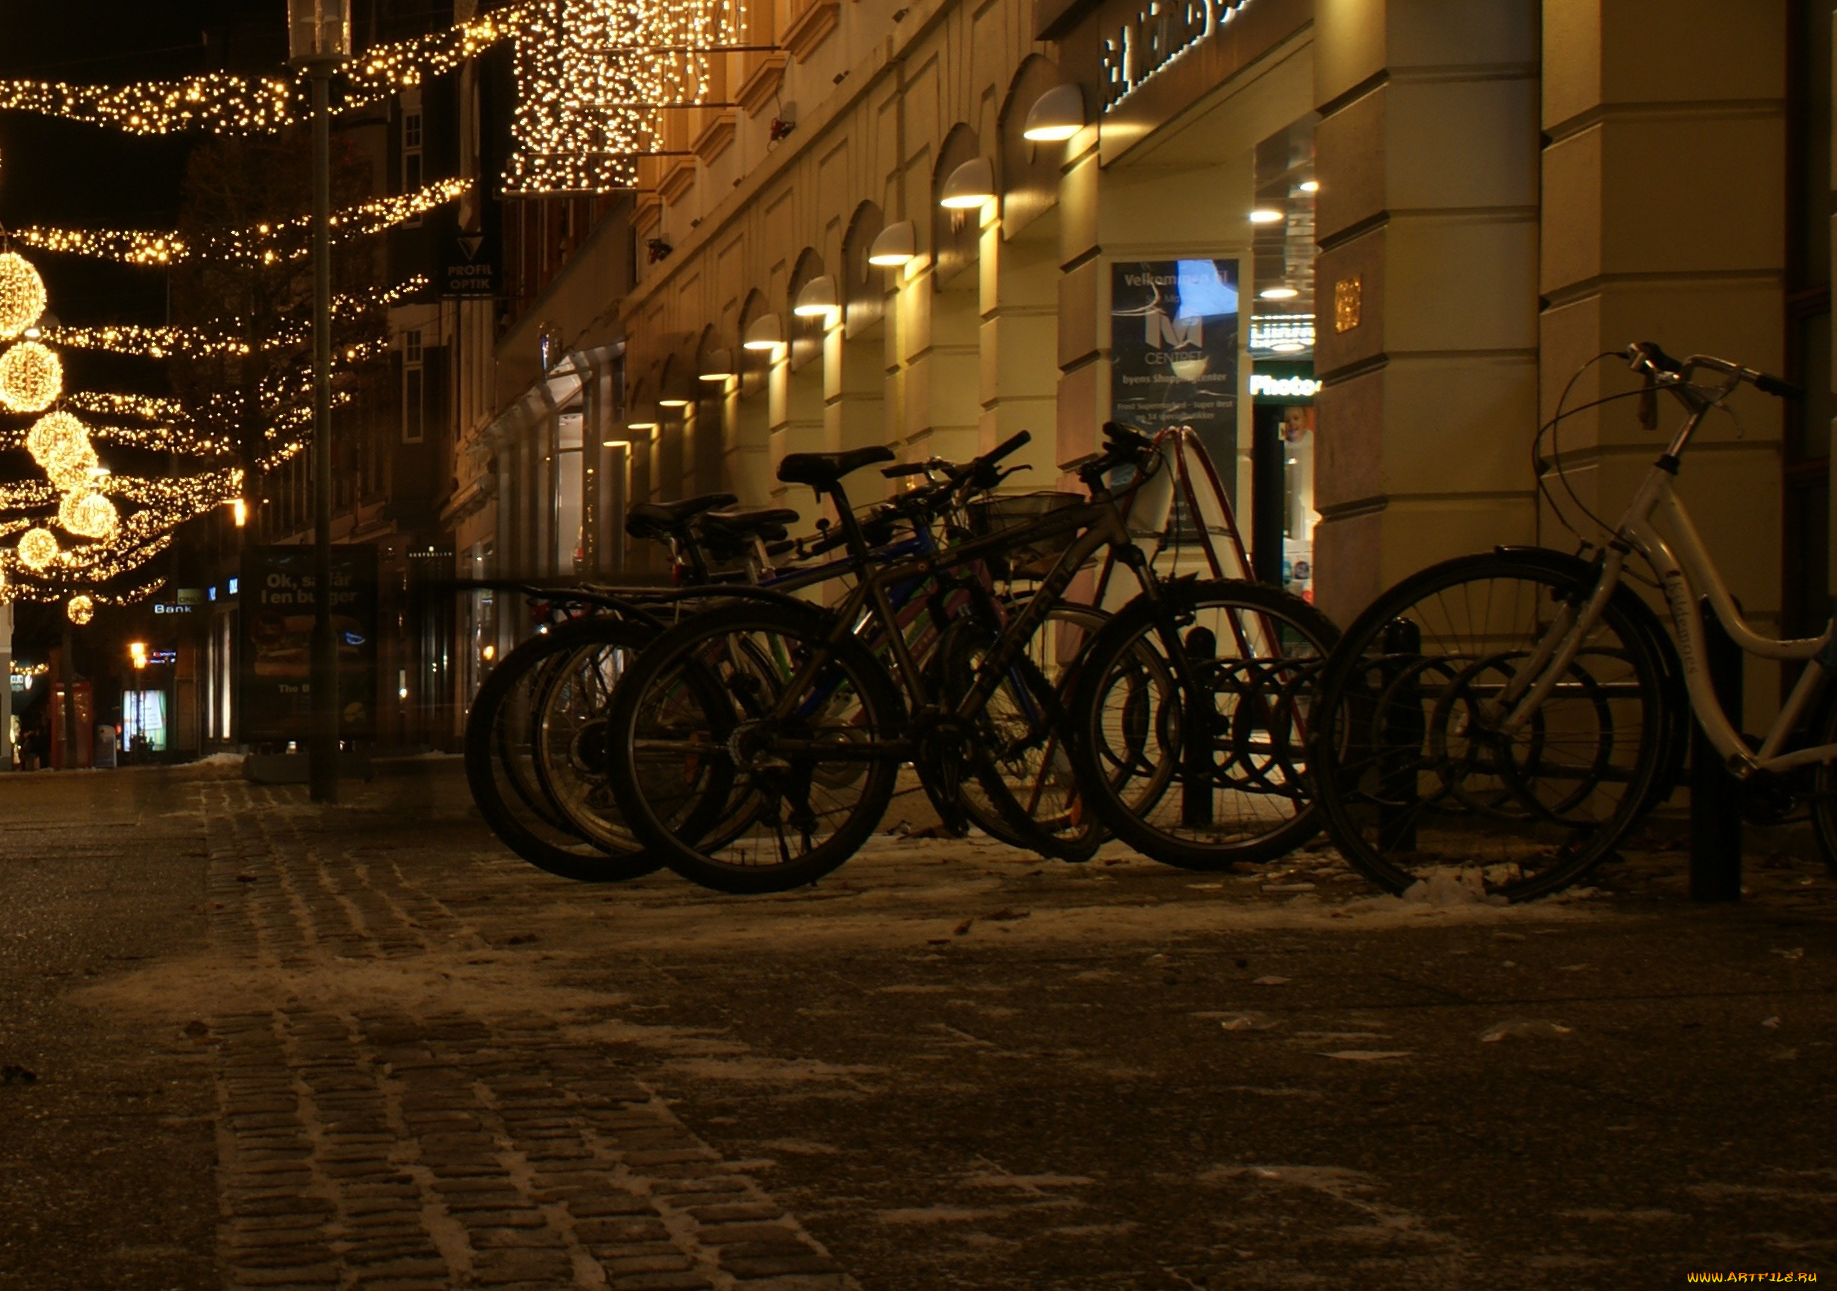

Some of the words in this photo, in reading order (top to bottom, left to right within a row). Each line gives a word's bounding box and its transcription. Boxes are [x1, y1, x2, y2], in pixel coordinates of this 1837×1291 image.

[448, 265, 493, 276] PROFIL
[450, 279, 490, 289] OPTIK
[1122, 374, 1151, 385] byens
[1153, 373, 1227, 385] Shoppgcenter
[267, 573, 297, 589] Ok,
[297, 590, 358, 605] buger
[154, 604, 192, 613] Bank
